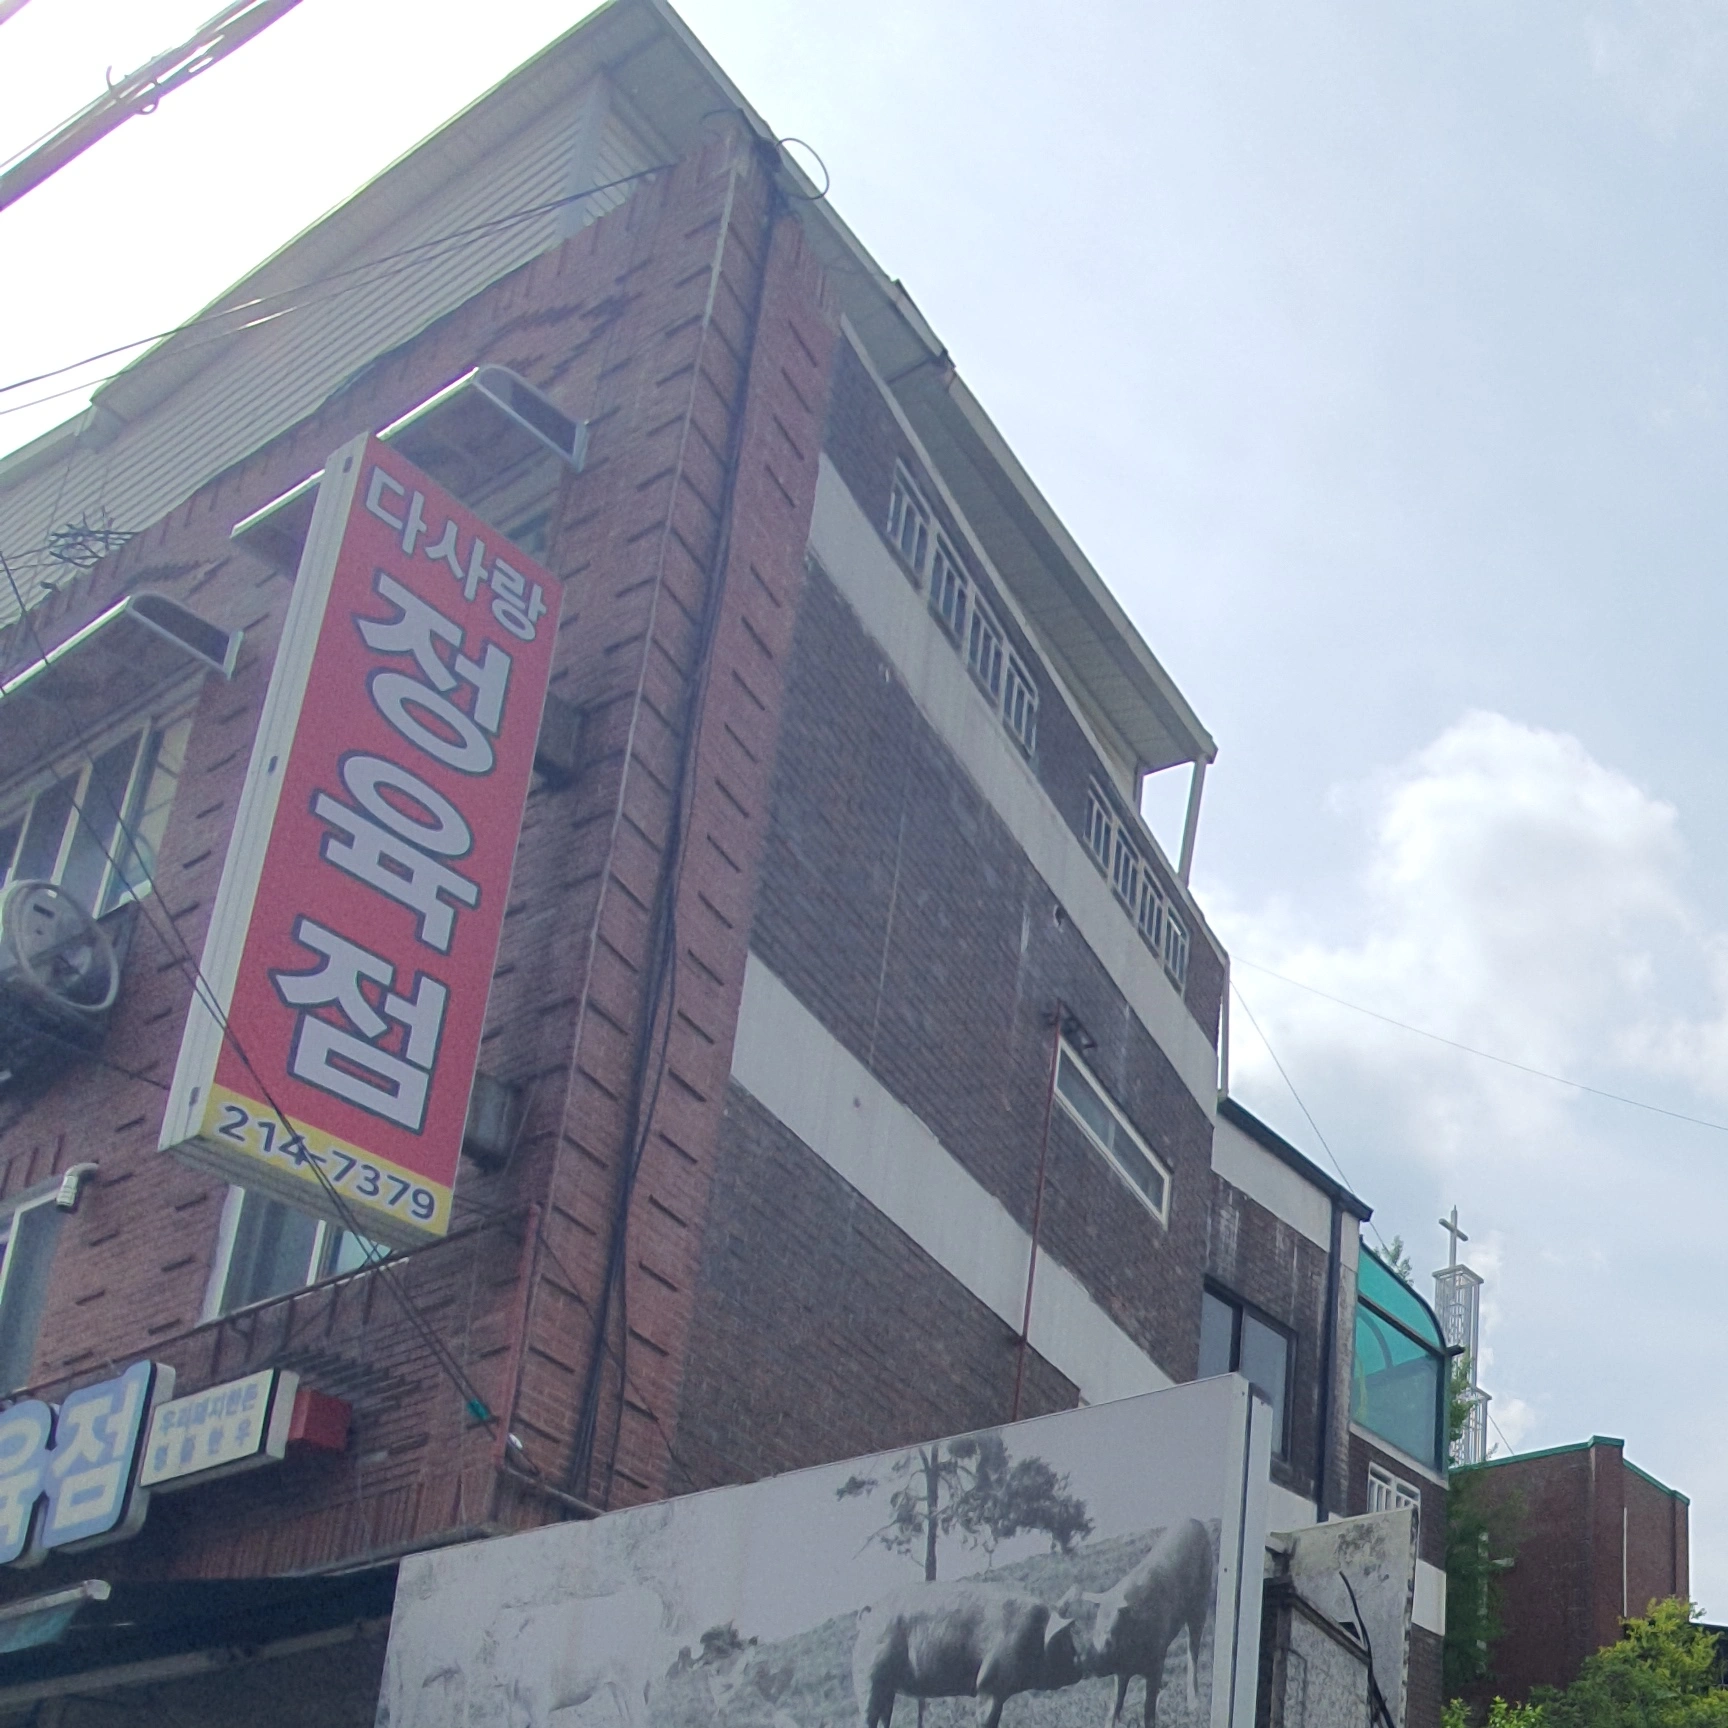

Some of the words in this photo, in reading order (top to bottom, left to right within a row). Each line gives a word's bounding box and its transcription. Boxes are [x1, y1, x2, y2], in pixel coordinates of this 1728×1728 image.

[366, 465, 548, 641] 다사랑
[272, 568, 513, 1134] 정육점
[218, 1105, 436, 1220] 214-7379
